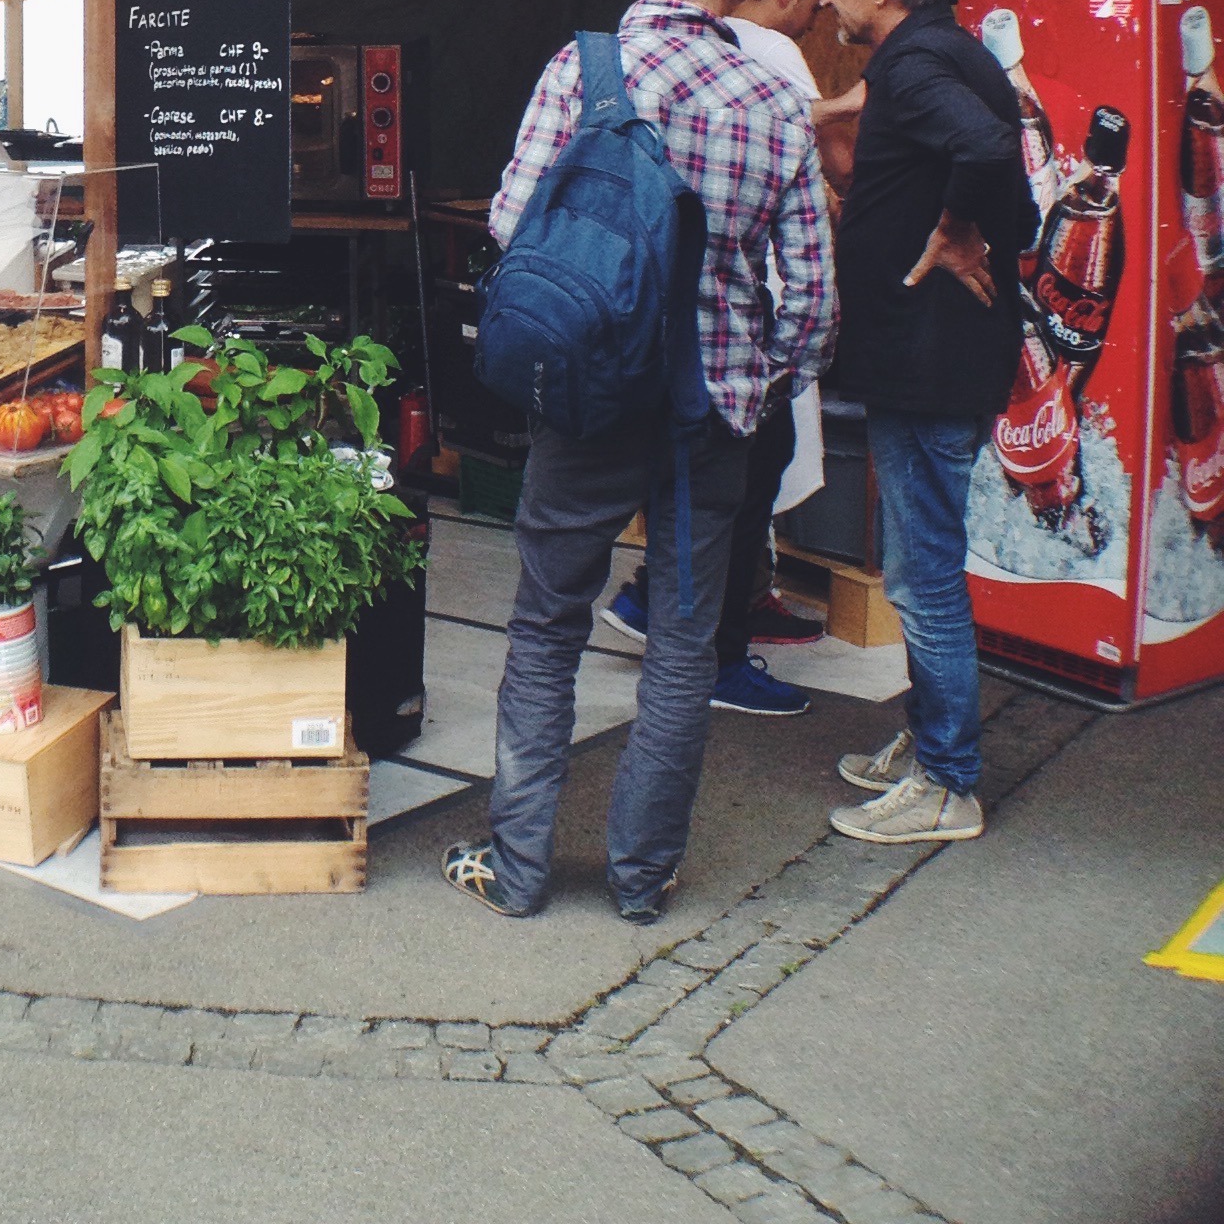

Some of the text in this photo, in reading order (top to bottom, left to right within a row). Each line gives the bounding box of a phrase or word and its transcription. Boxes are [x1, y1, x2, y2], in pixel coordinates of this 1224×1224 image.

[128, 6, 190, 28] FARCITE
[219, 43, 245, 58] CHF
[220, 109, 247, 124] CHF
